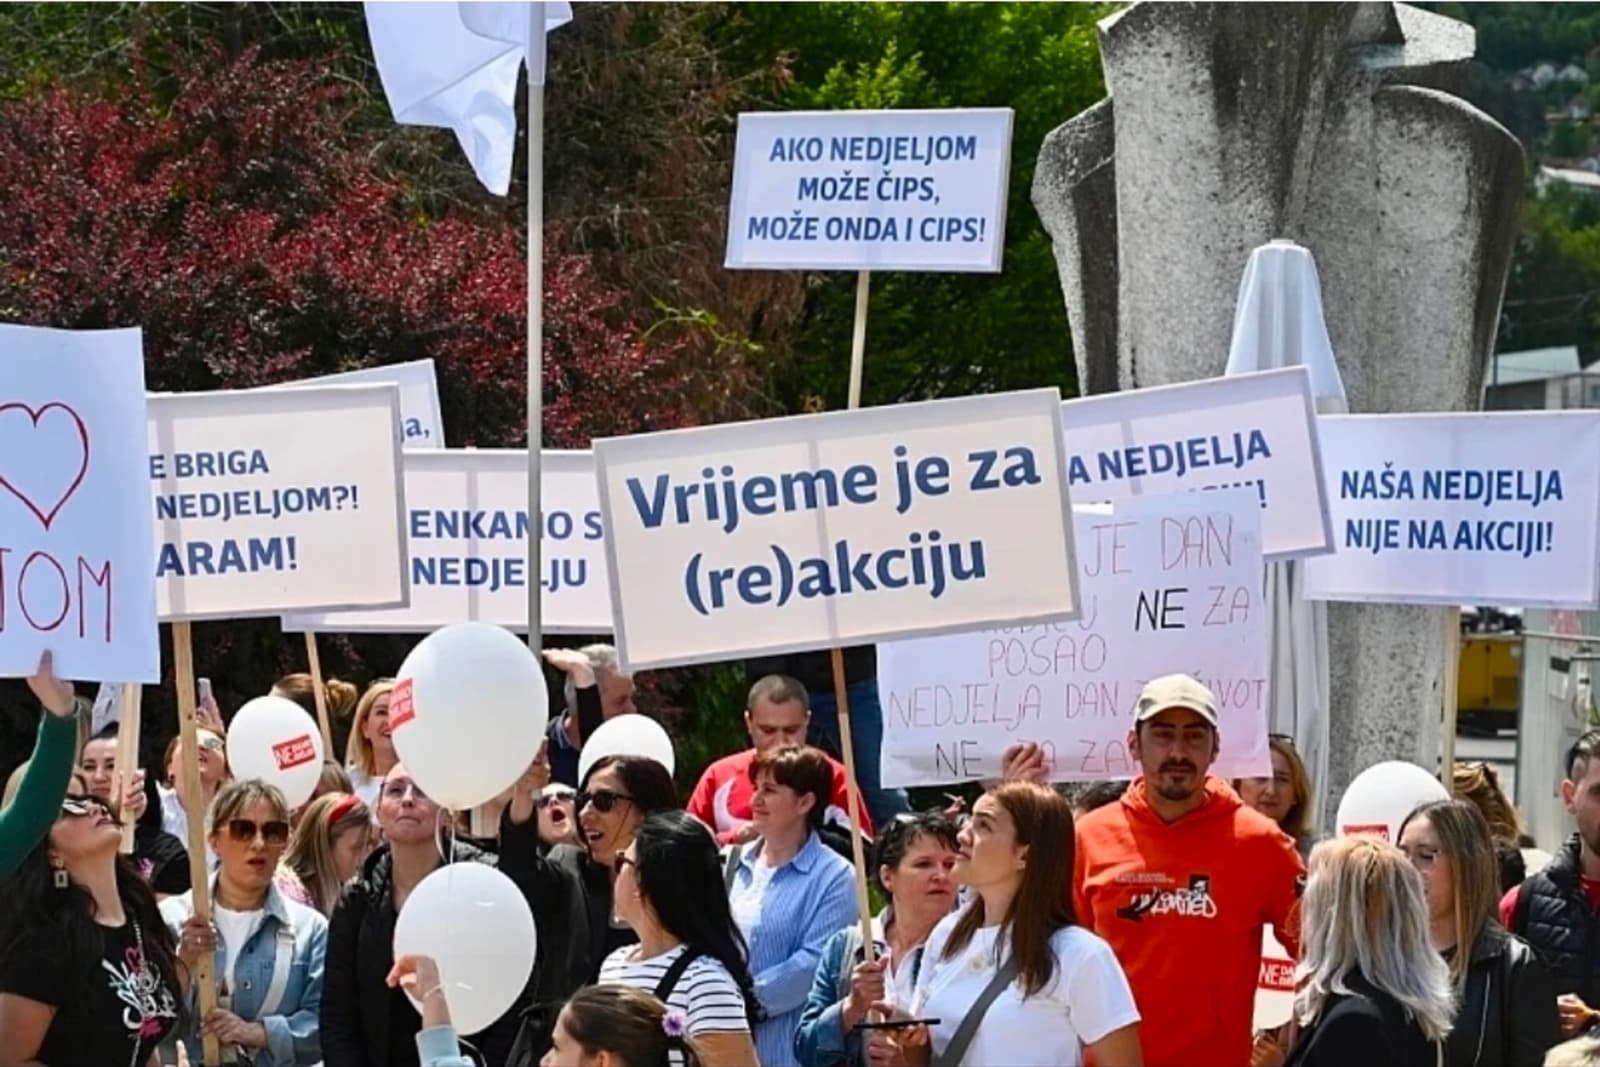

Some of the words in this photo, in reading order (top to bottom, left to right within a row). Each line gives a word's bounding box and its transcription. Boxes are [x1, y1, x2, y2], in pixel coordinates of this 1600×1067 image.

[769, 137, 823, 162] AKO
[830, 136, 976, 166] NEDJELJOM
[798, 169, 870, 201] MOŽE
[876, 169, 940, 205] ČIPS,
[748, 209, 819, 241] MOŽE
[825, 217, 898, 242] ONDA
[905, 217, 913, 242] I
[920, 217, 986, 242] CIPS!
[174, 450, 269, 478] BRIGA
[1068, 455, 1091, 486] A
[1098, 429, 1272, 478] NEDJELJA
[156, 485, 358, 522] NEDJELJOM?!
[626, 463, 878, 534] Vrijeme
[894, 445, 950, 514] je
[968, 444, 1041, 490] za
[1340, 461, 1414, 499] NAŠA
[1422, 469, 1563, 507] NEDJELJA
[156, 536, 297, 577] ARAM!
[1084, 522, 1138, 578] JE
[1160, 513, 1233, 572] DAN
[1345, 519, 1399, 554] NIJE
[1408, 520, 1448, 550] NA
[1453, 521, 1553, 558] AKCIJI!
[685, 530, 987, 616] (re)akciju
[1135, 587, 1188, 632] NE
[1202, 585, 1250, 626] ZA
[988, 633, 1107, 678] POSAO
[1066, 680, 1119, 719] DAN
[1192, 669, 1266, 710] VOT
[935, 740, 984, 777] NE
[1079, 739, 1137, 774] ZA
